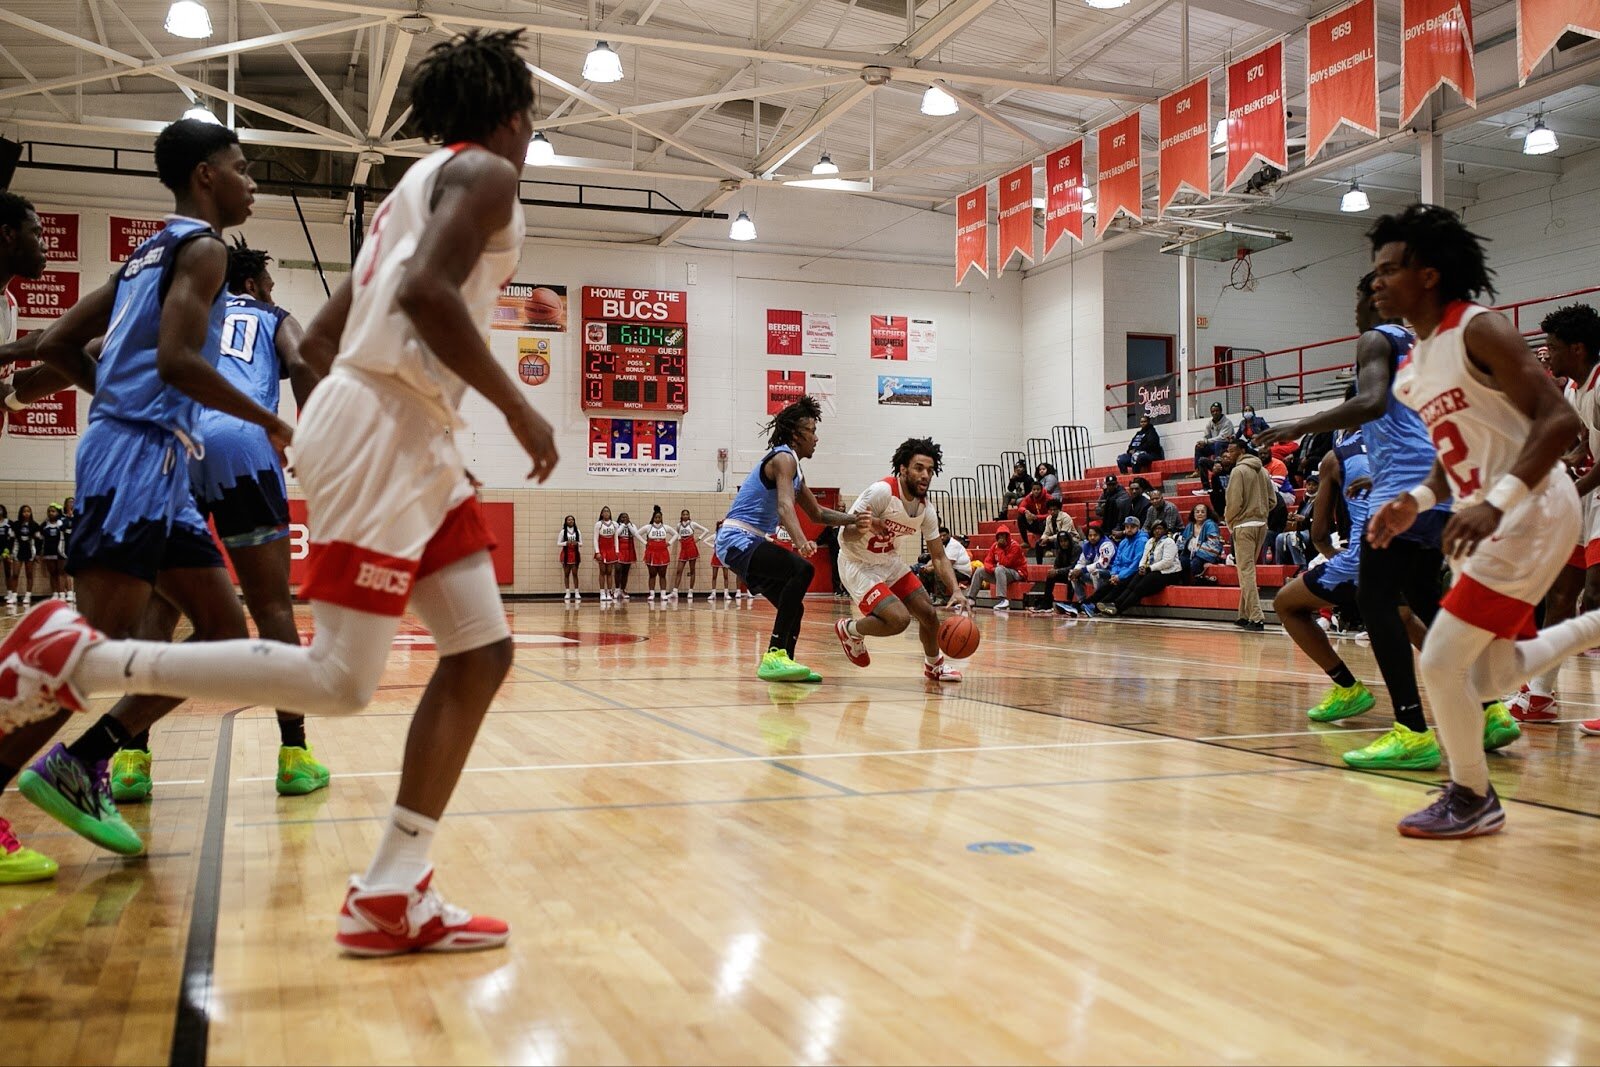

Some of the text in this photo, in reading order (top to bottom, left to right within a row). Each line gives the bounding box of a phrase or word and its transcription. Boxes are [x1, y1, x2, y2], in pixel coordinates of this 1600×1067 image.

[1426, 7, 1457, 31] BASKET
[1331, 21, 1352, 42] 1969
[1329, 47, 1373, 77] BASKETBALL
[1247, 64, 1264, 83] 1970
[1176, 97, 1191, 115] 1974
[1244, 89, 1280, 115] BASKETBALL
[1173, 122, 1208, 147] BASKETBALL
[41, 216, 56, 225] ATE
[131, 221, 157, 229] STATE
[42, 226, 66, 235] PIONS
[44, 236, 59, 249] 12
[128, 235, 147, 247] 20
[46, 250, 77, 259] KETBALL
[20, 282, 66, 292] CHAMPIONS
[27, 293, 59, 306] 2013
[590, 288, 680, 302] HOME OF THE
[30, 307, 68, 315] BASKETBA
[602, 299, 669, 320] BUCS
[768, 323, 801, 332] BEECHER
[872, 329, 906, 338] BEECHER
[621, 325, 663, 346] 6:04
[589, 344, 612, 352] HOME
[657, 347, 682, 355] GUEST
[590, 353, 615, 372] 24
[660, 356, 684, 375] 24
[590, 381, 602, 400] 0
[673, 383, 684, 403] 2
[768, 384, 804, 393] BEECHER
[1138, 385, 1171, 405] Student
[26, 412, 57, 425] 2016
[8, 424, 76, 434] BOYS BASKETBALL
[355, 561, 412, 597] BUCS
